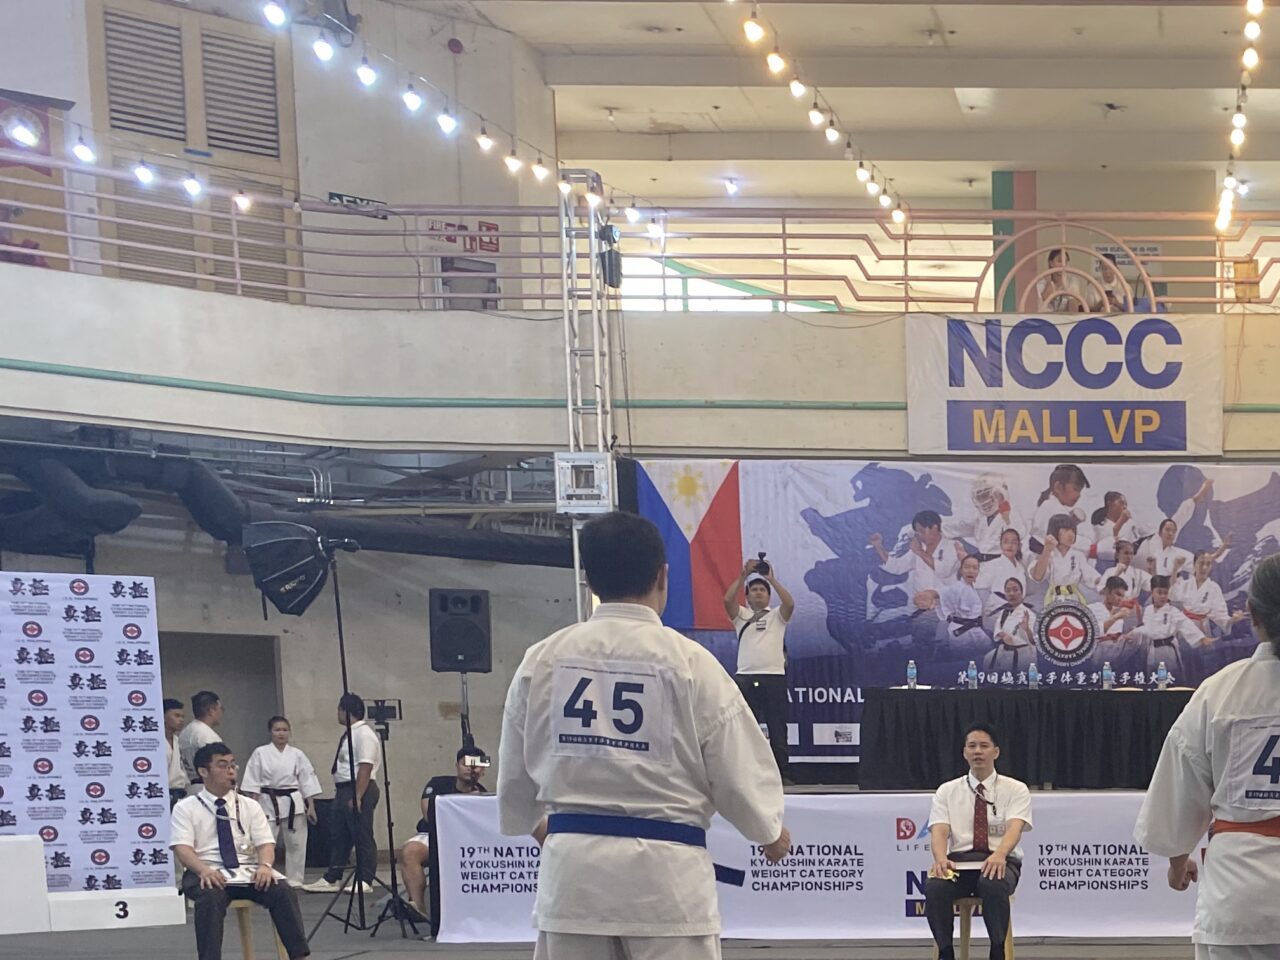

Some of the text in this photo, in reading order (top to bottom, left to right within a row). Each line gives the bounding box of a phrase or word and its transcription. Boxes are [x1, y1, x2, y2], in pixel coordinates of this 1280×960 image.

[947, 318, 1183, 389] NCCC
[973, 409, 1161, 443] MALL VP
[787, 687, 864, 703] TIONAL
[563, 677, 644, 734] 45
[460, 846, 540, 858] 19TH NATIO
[750, 845, 765, 856] 19
[1038, 844, 1149, 855] 19TH NATIONAL
[460, 860, 525, 869] KYOKUSHIN
[750, 858, 864, 867] KYOKUSHIN KARATE
[1038, 858, 1149, 866] KYOKUSHIN KARATE
[461, 871, 539, 880] WEIGHT CATE
[751, 869, 864, 878] WEIGHT CATEGORY
[1039, 869, 1149, 877] WEIGHT CATEGORY
[461, 883, 538, 893] CHAMPIONS
[751, 881, 864, 891] CHAMPIONSHIPS
[1039, 880, 1149, 890] CHAMPIONSHIPS
[115, 900, 129, 919] 3
